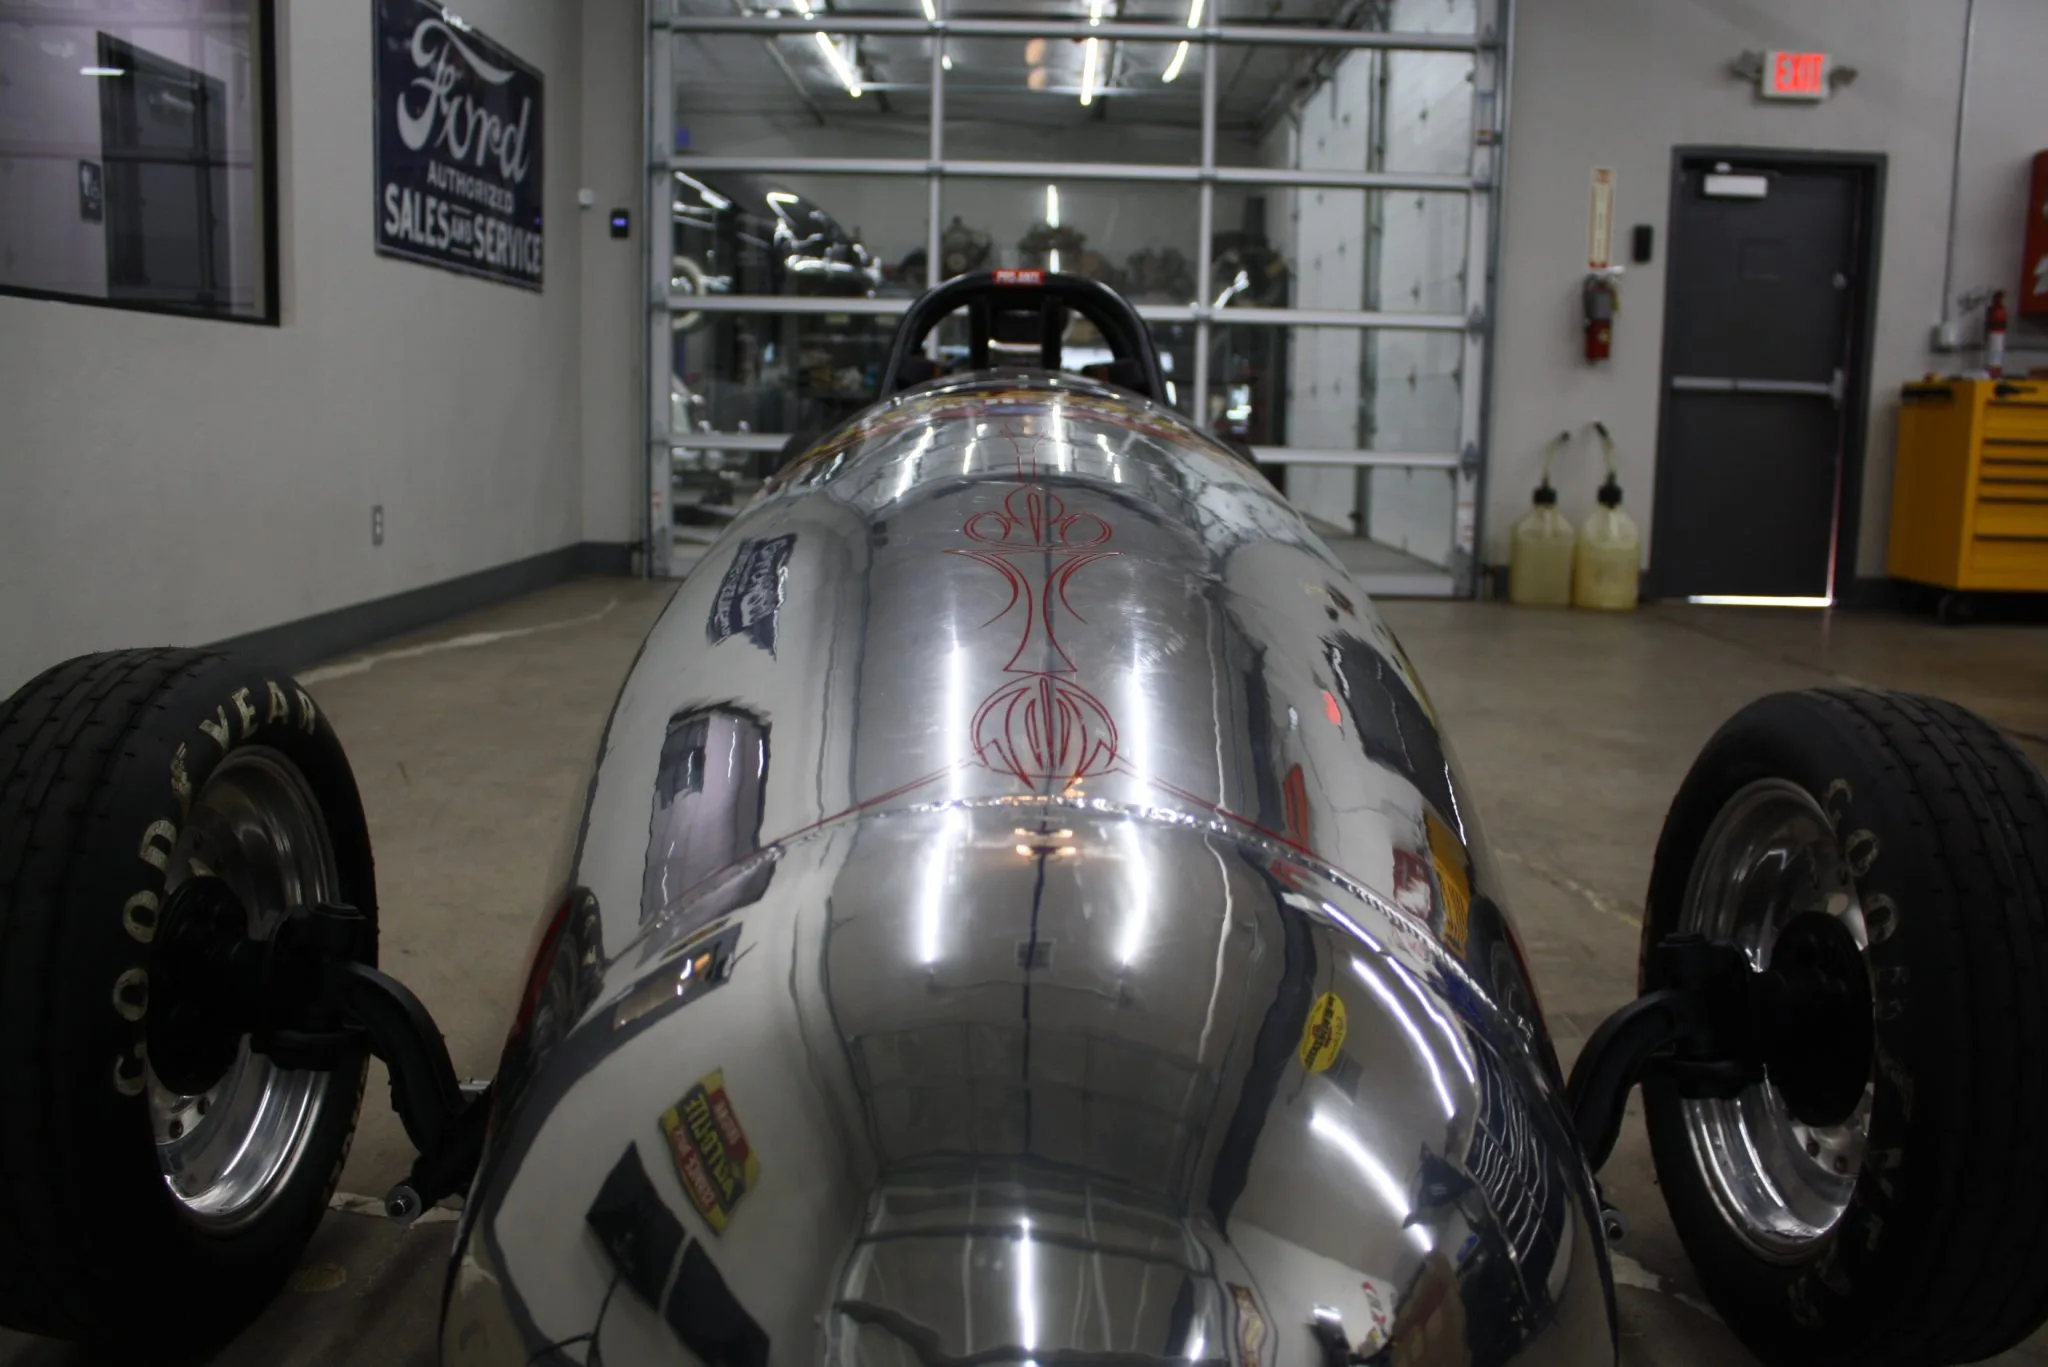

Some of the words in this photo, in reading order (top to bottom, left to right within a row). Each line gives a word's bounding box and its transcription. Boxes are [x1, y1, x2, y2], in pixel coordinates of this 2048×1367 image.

[397, 18, 531, 183] Ford
[1776, 50, 1824, 95] EXIT
[427, 160, 515, 213] AUTHORIZED
[384, 182, 449, 249] SALES
[451, 212, 472, 243] AND
[474, 212, 542, 275] SERVICE
